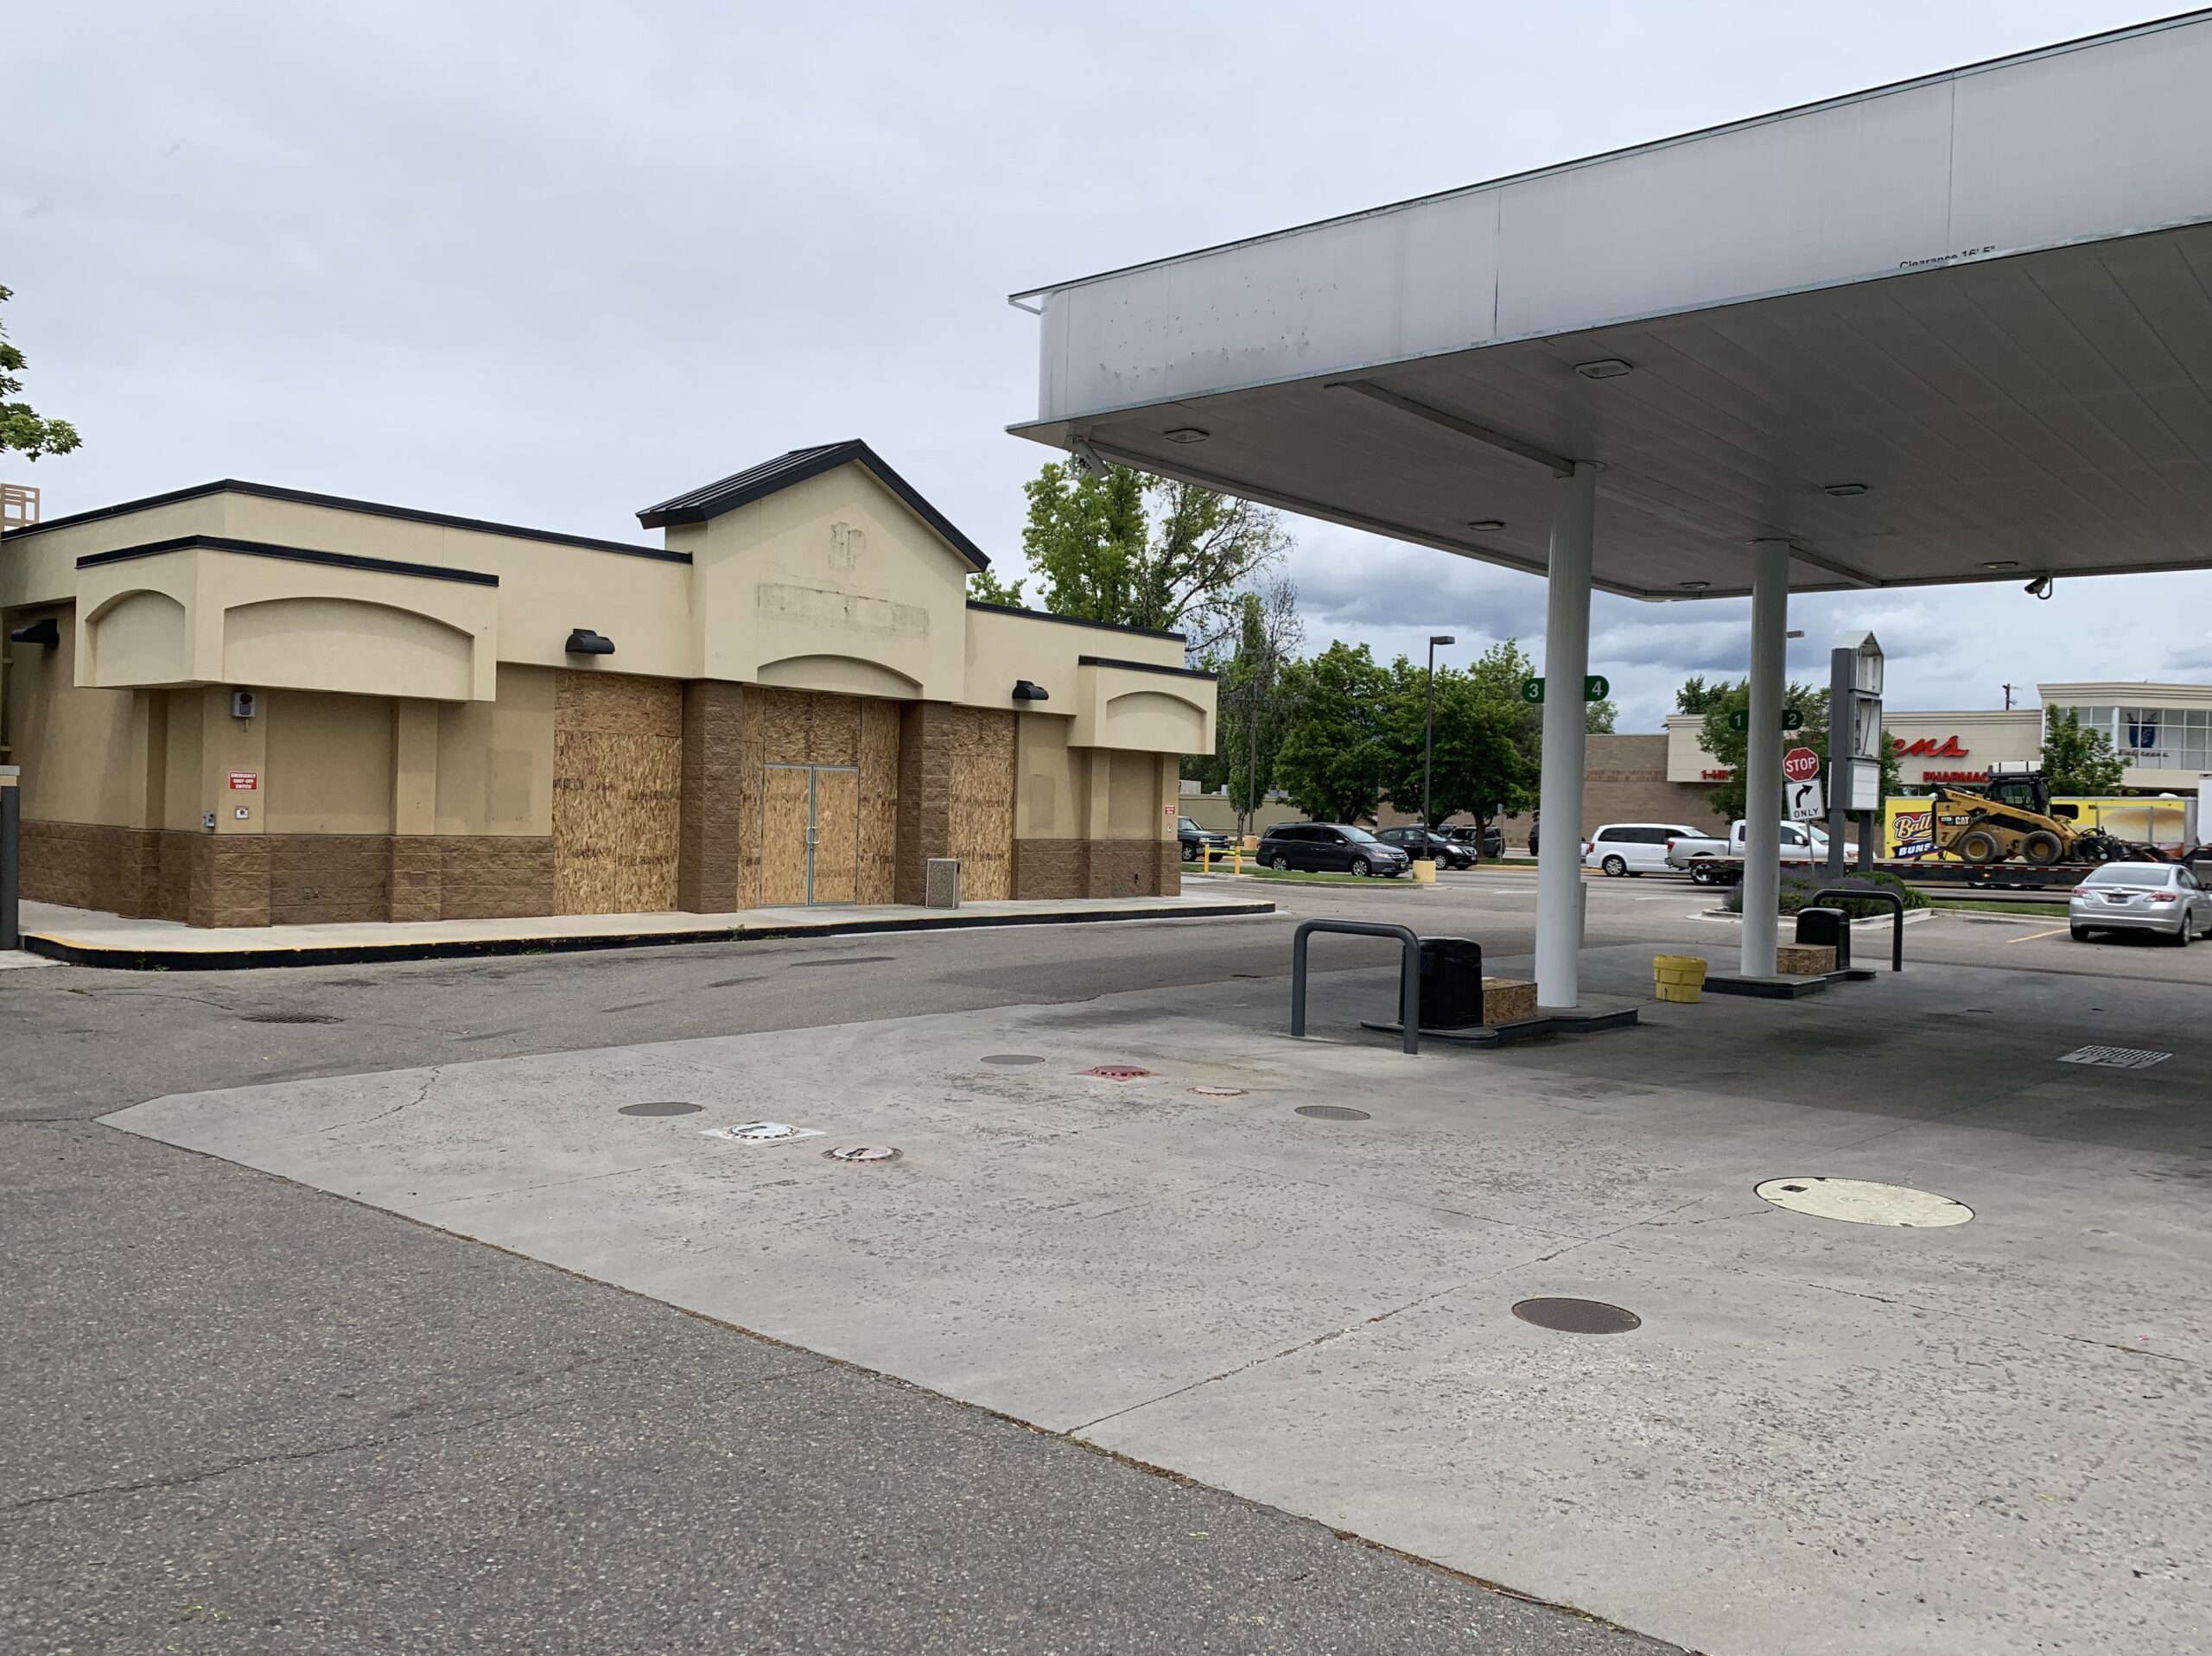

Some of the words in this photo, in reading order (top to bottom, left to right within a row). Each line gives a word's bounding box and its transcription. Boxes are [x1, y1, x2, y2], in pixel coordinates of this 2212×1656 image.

[1529, 683, 1539, 698] 3
[1592, 681, 1603, 696] 4
[1734, 714, 1741, 726] 1
[1788, 714, 1797, 726] 2
[1785, 757, 1817, 773] STOP
[1923, 771, 1992, 784] PHARMAC
[1794, 808, 1819, 818] ONLY
[1895, 815, 1932, 838] Ball
[1955, 815, 1970, 825] CAT
[1898, 843, 1931, 856] BUNS
